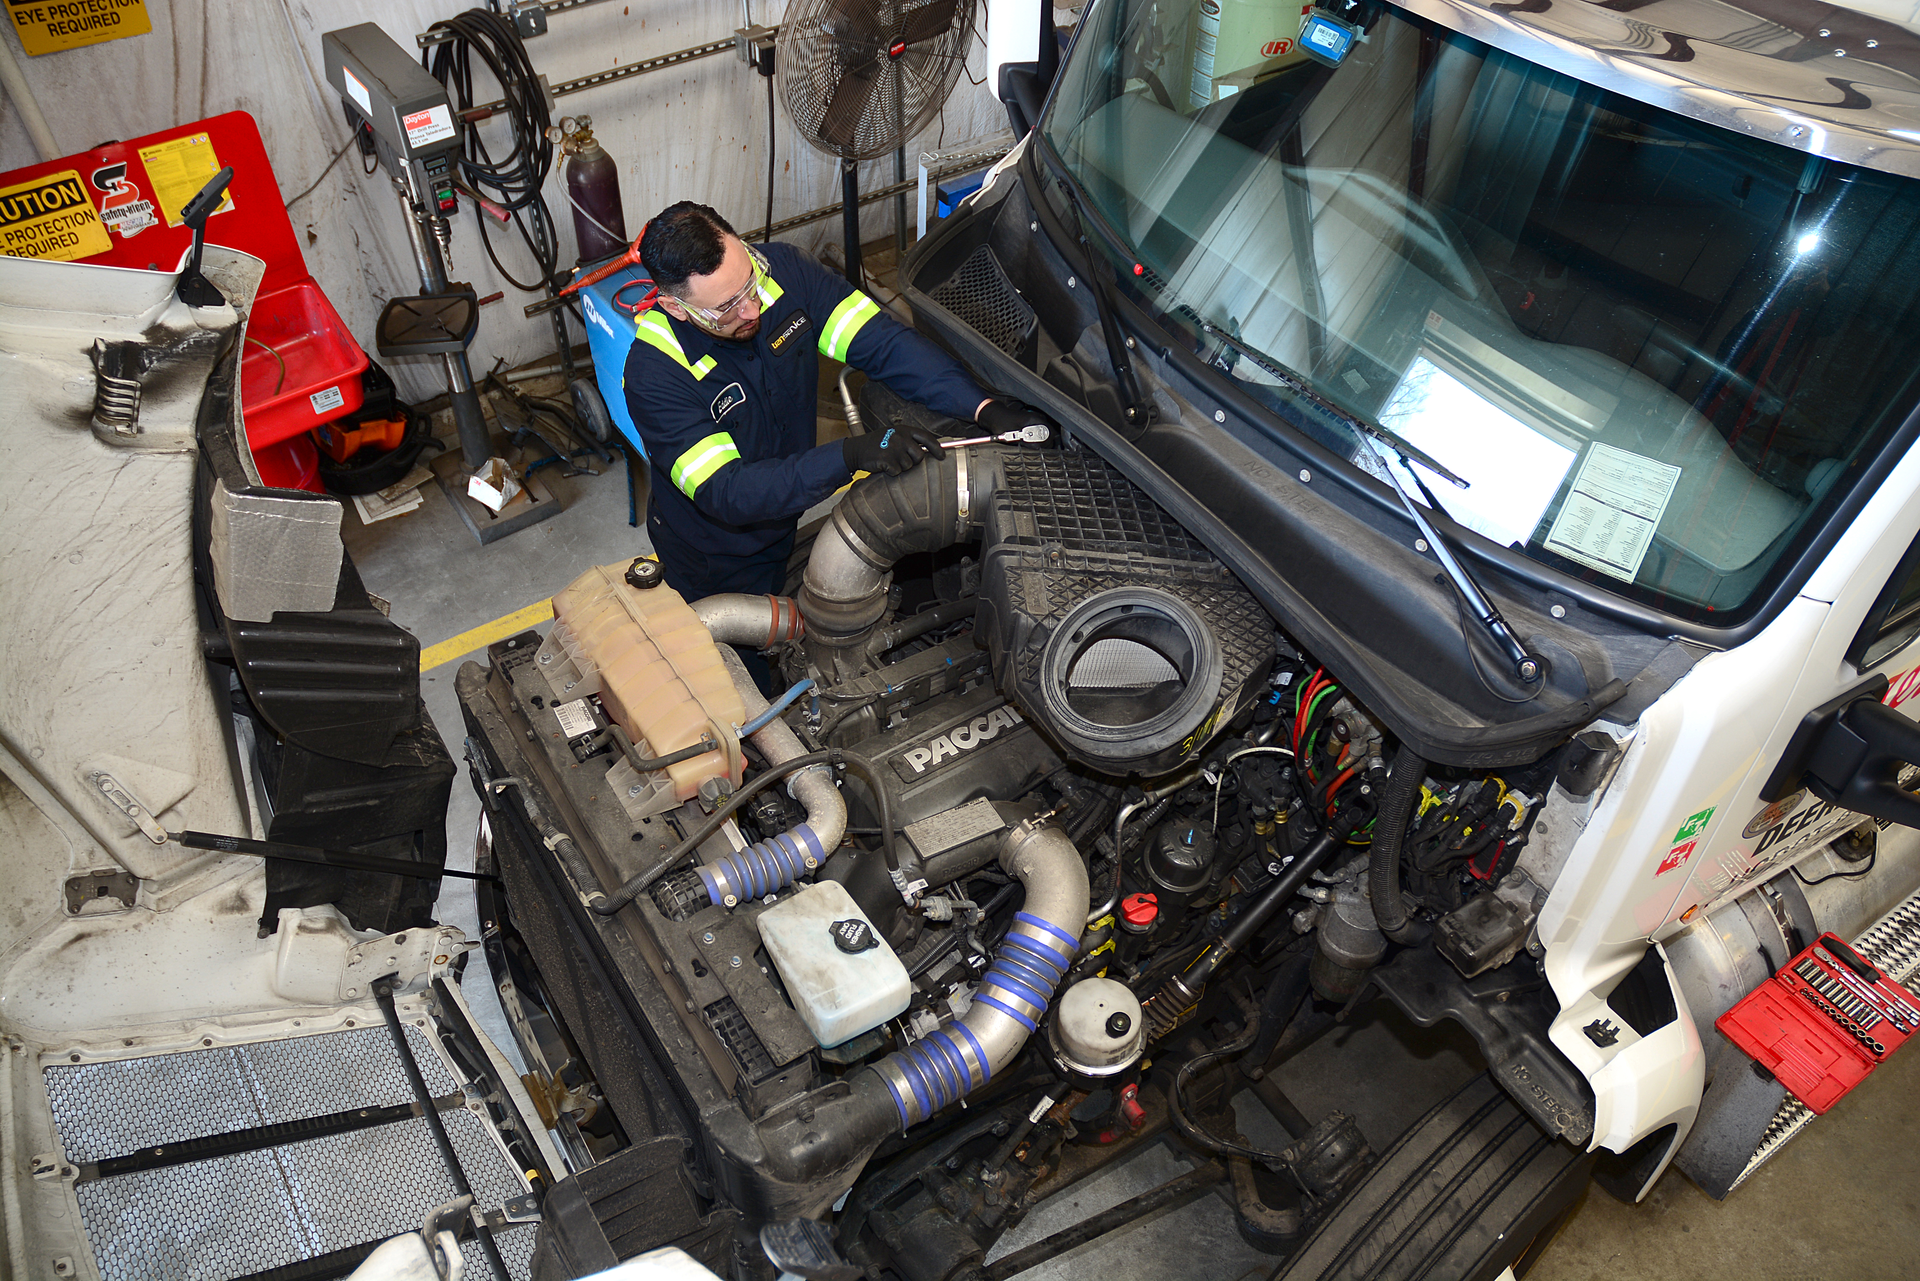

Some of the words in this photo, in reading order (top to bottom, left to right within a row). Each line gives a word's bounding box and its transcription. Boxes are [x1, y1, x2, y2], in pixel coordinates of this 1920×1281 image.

[14, 9, 47, 26] EYE
[46, 11, 122, 37] REQUIRED
[1265, 41, 1289, 54] IR
[405, 112, 431, 125] Dayton
[0, 182, 82, 224] UTION
[4, 208, 97, 246] PROTECTION
[6, 231, 80, 258] REQUIRED
[1243, 460, 1272, 479] NO
[1276, 484, 1325, 515] STEP
[839, 922, 850, 936] ONLY
[844, 923, 858, 939] FLUID
[849, 923, 867, 945] WASHER
[1511, 1064, 1531, 1084] NO
[1531, 1085, 1562, 1113] STEP
